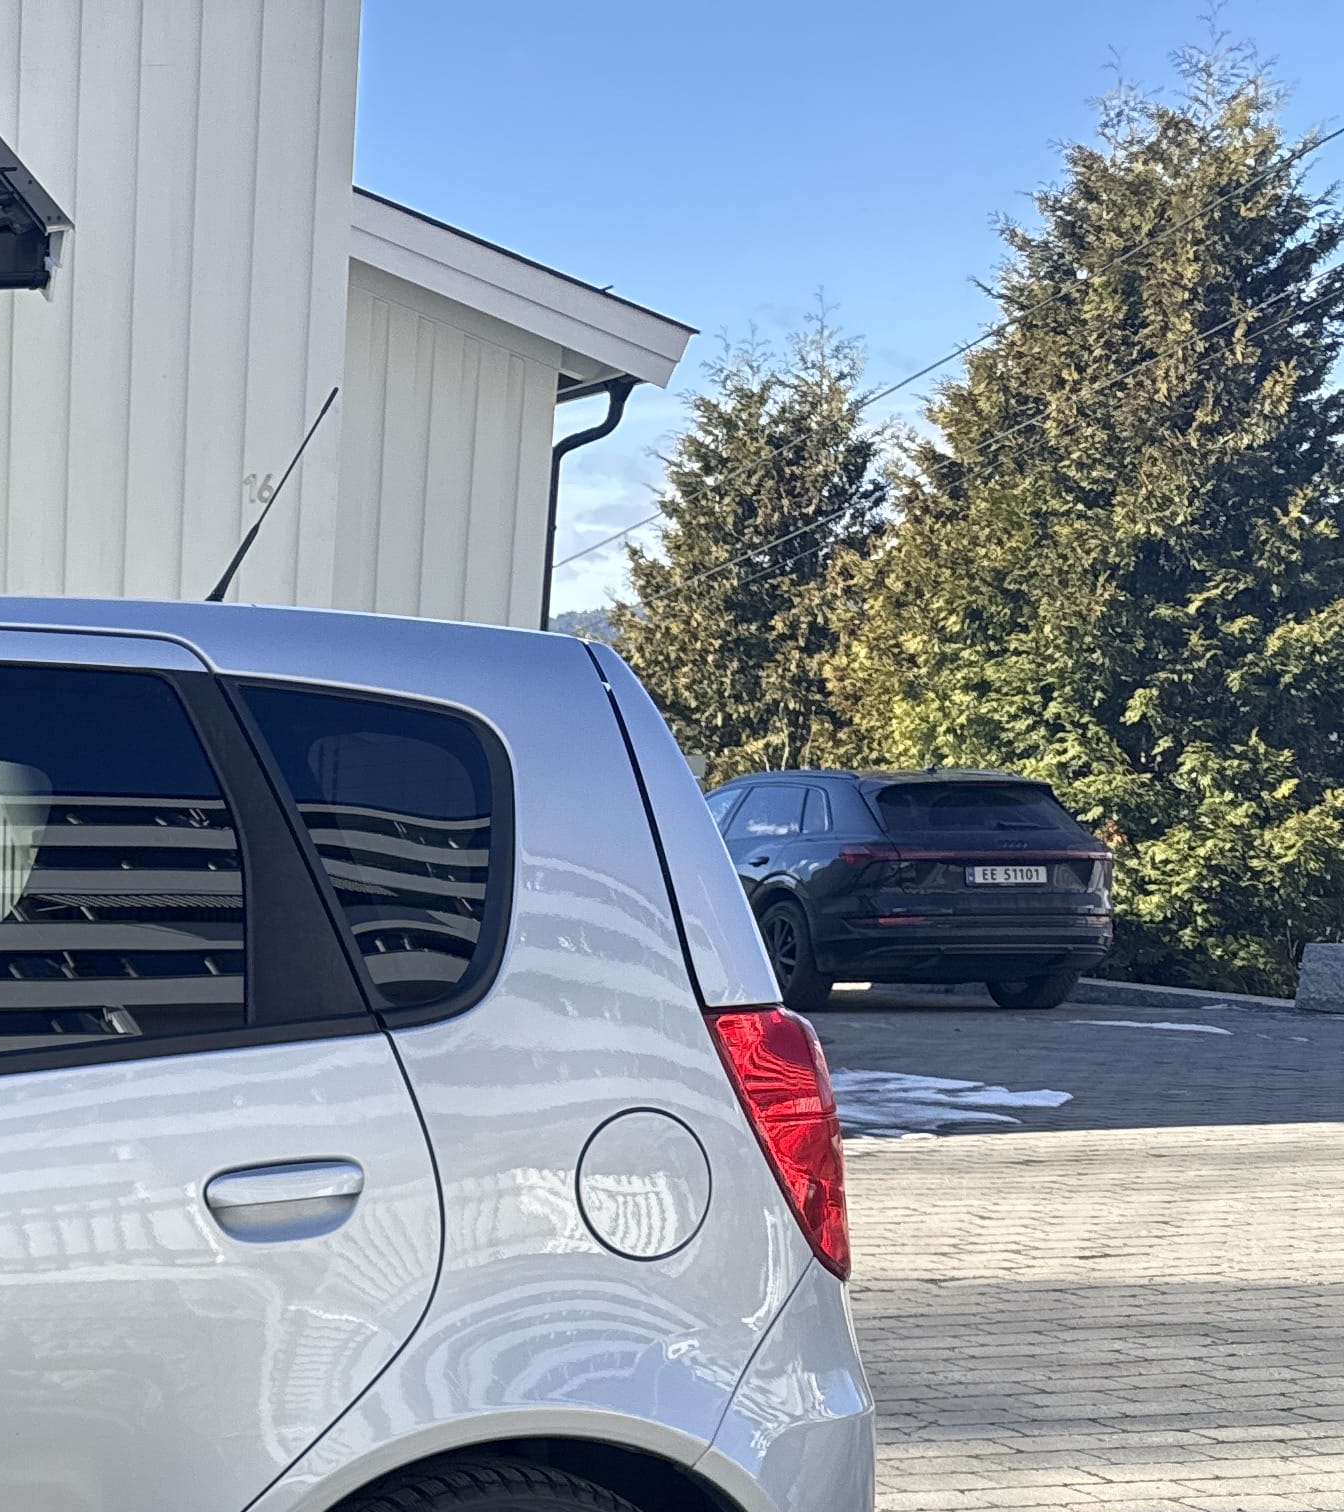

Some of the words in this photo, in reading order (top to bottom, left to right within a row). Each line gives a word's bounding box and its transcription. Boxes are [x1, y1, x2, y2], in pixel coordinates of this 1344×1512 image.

[242, 473, 274, 504] 16
[982, 868, 998, 881] EE
[1003, 868, 1040, 881] 51101
